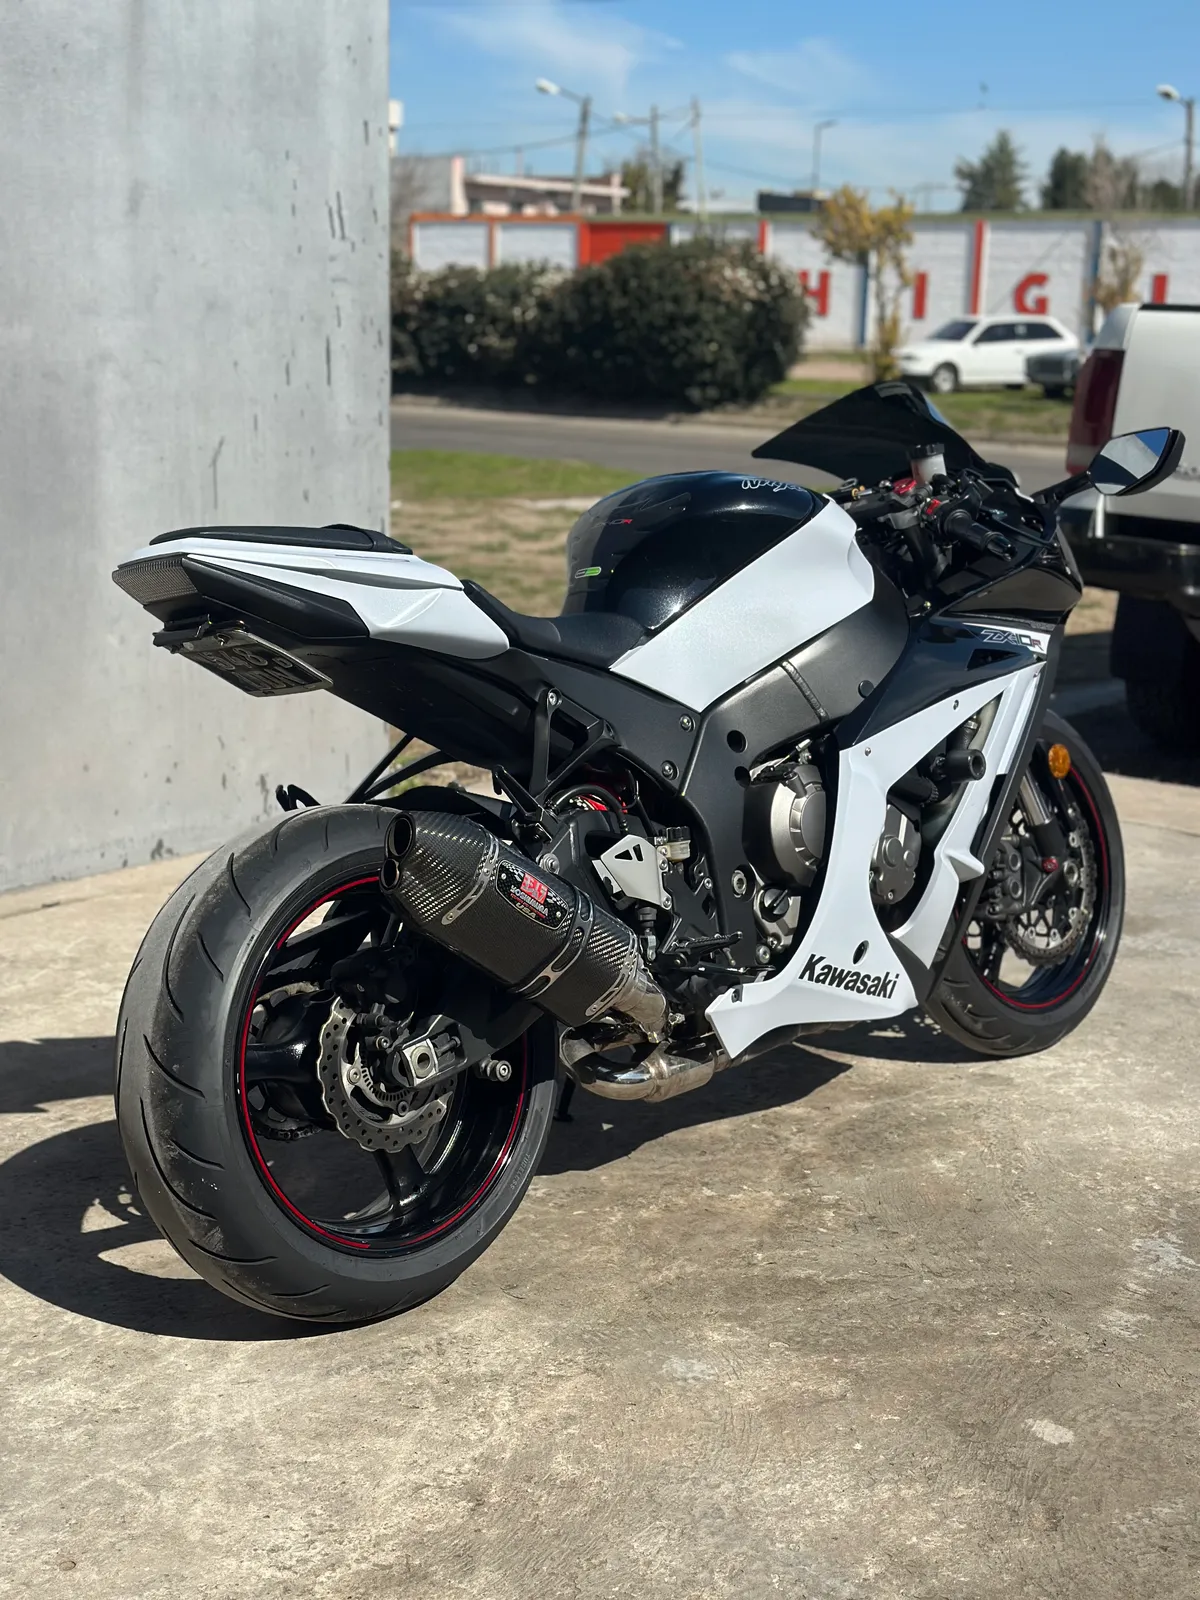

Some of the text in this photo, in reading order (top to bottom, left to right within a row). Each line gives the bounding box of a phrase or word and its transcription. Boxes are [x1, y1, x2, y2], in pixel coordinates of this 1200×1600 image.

[1014, 273, 1049, 315] G
[515, 902, 537, 919] USA
[798, 953, 900, 999] Kawasaki
